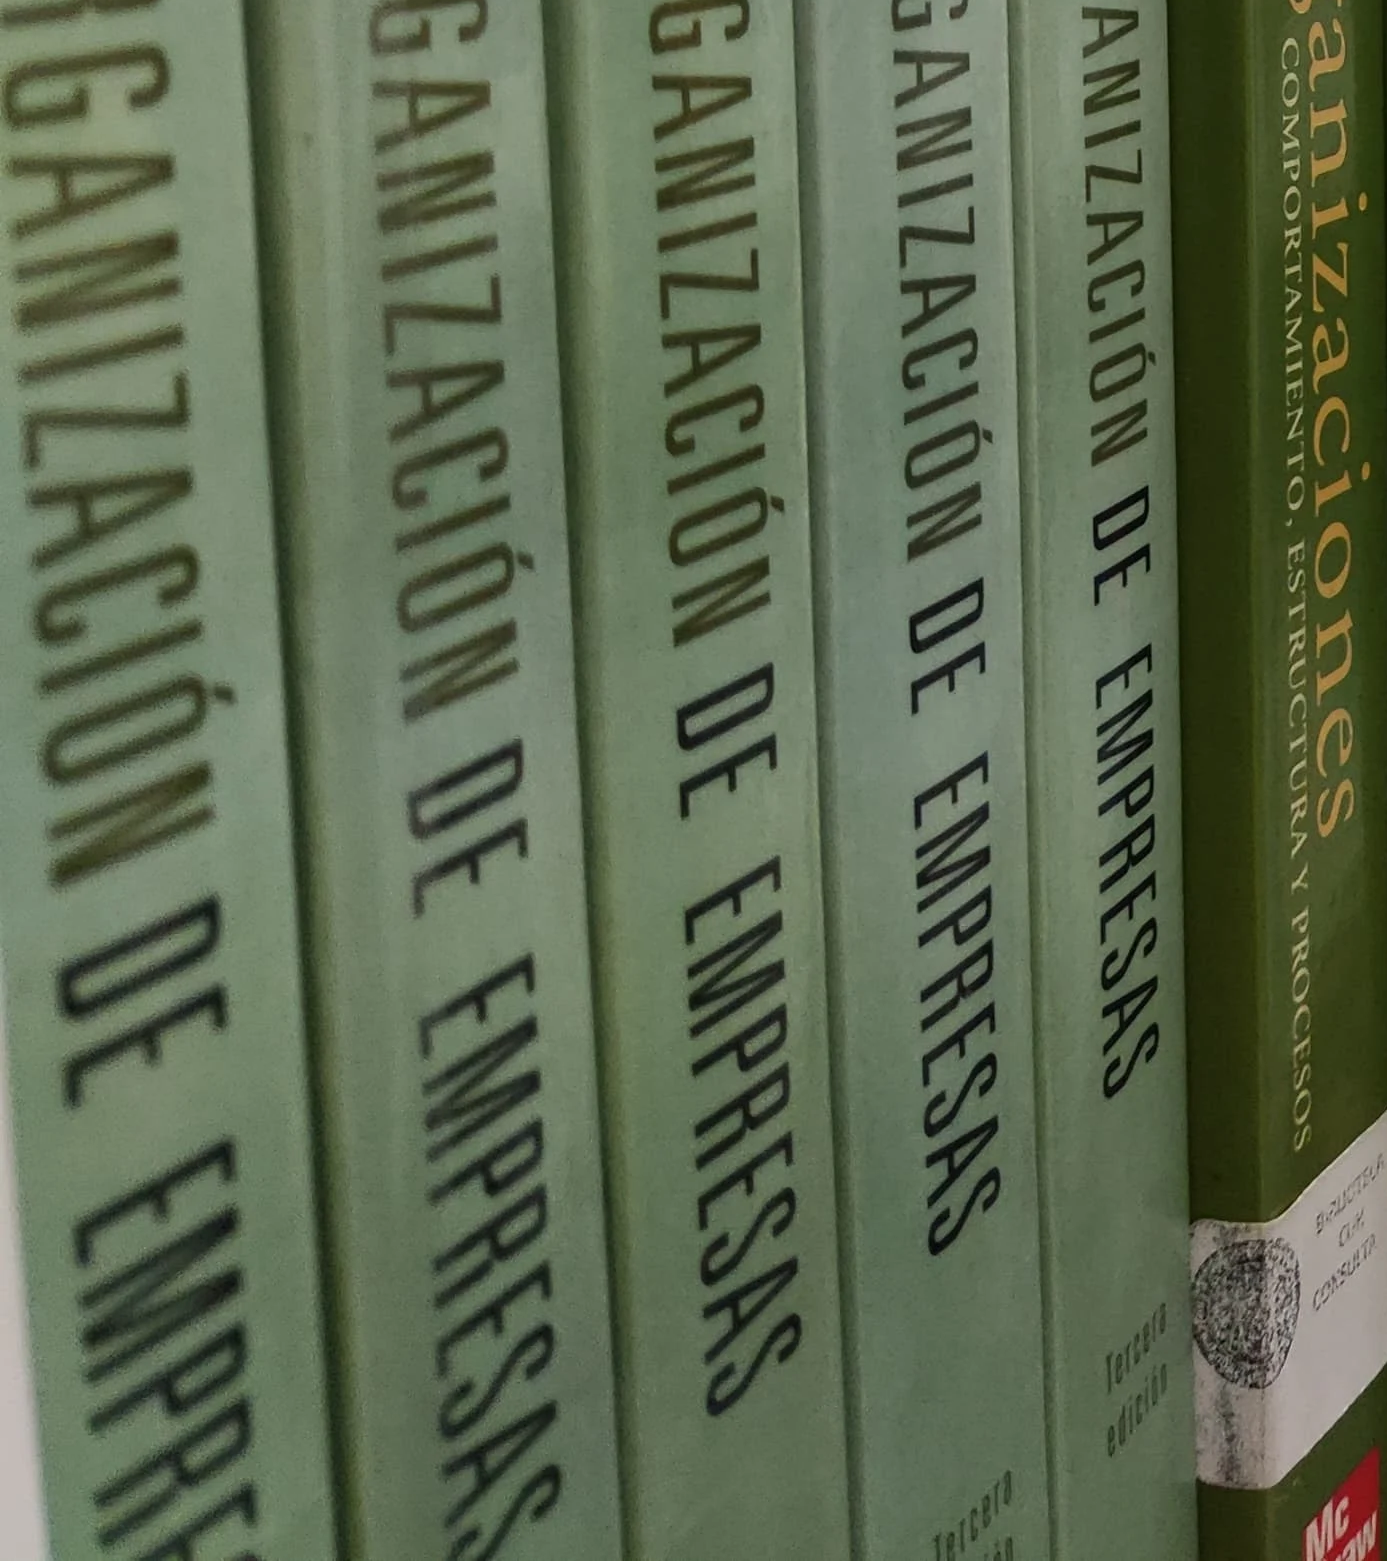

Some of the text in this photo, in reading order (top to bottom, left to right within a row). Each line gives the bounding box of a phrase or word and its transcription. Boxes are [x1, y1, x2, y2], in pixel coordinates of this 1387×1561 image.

[1093, 485, 1151, 606] DE
[1280, 37, 1312, 1154] COMPORTAMIENTO, ESTRUCTURA Y PROCESOS
[676, 662, 778, 820] DE
[909, 576, 987, 717] DE
[408, 738, 529, 919] DE
[1095, 644, 1160, 1100] EMPRESAS
[57, 893, 230, 1109] DE
[914, 750, 1001, 1257] EMPRESAS
[685, 856, 802, 1418] EMPRESAS
[74, 1136, 260, 1561] EMPRE
[418, 952, 564, 1561] EMPRESAS
[1104, 1302, 1169, 1395] Tercera
[1107, 1361, 1169, 1459] edición
[1303, 1496, 1351, 1561] Mc
